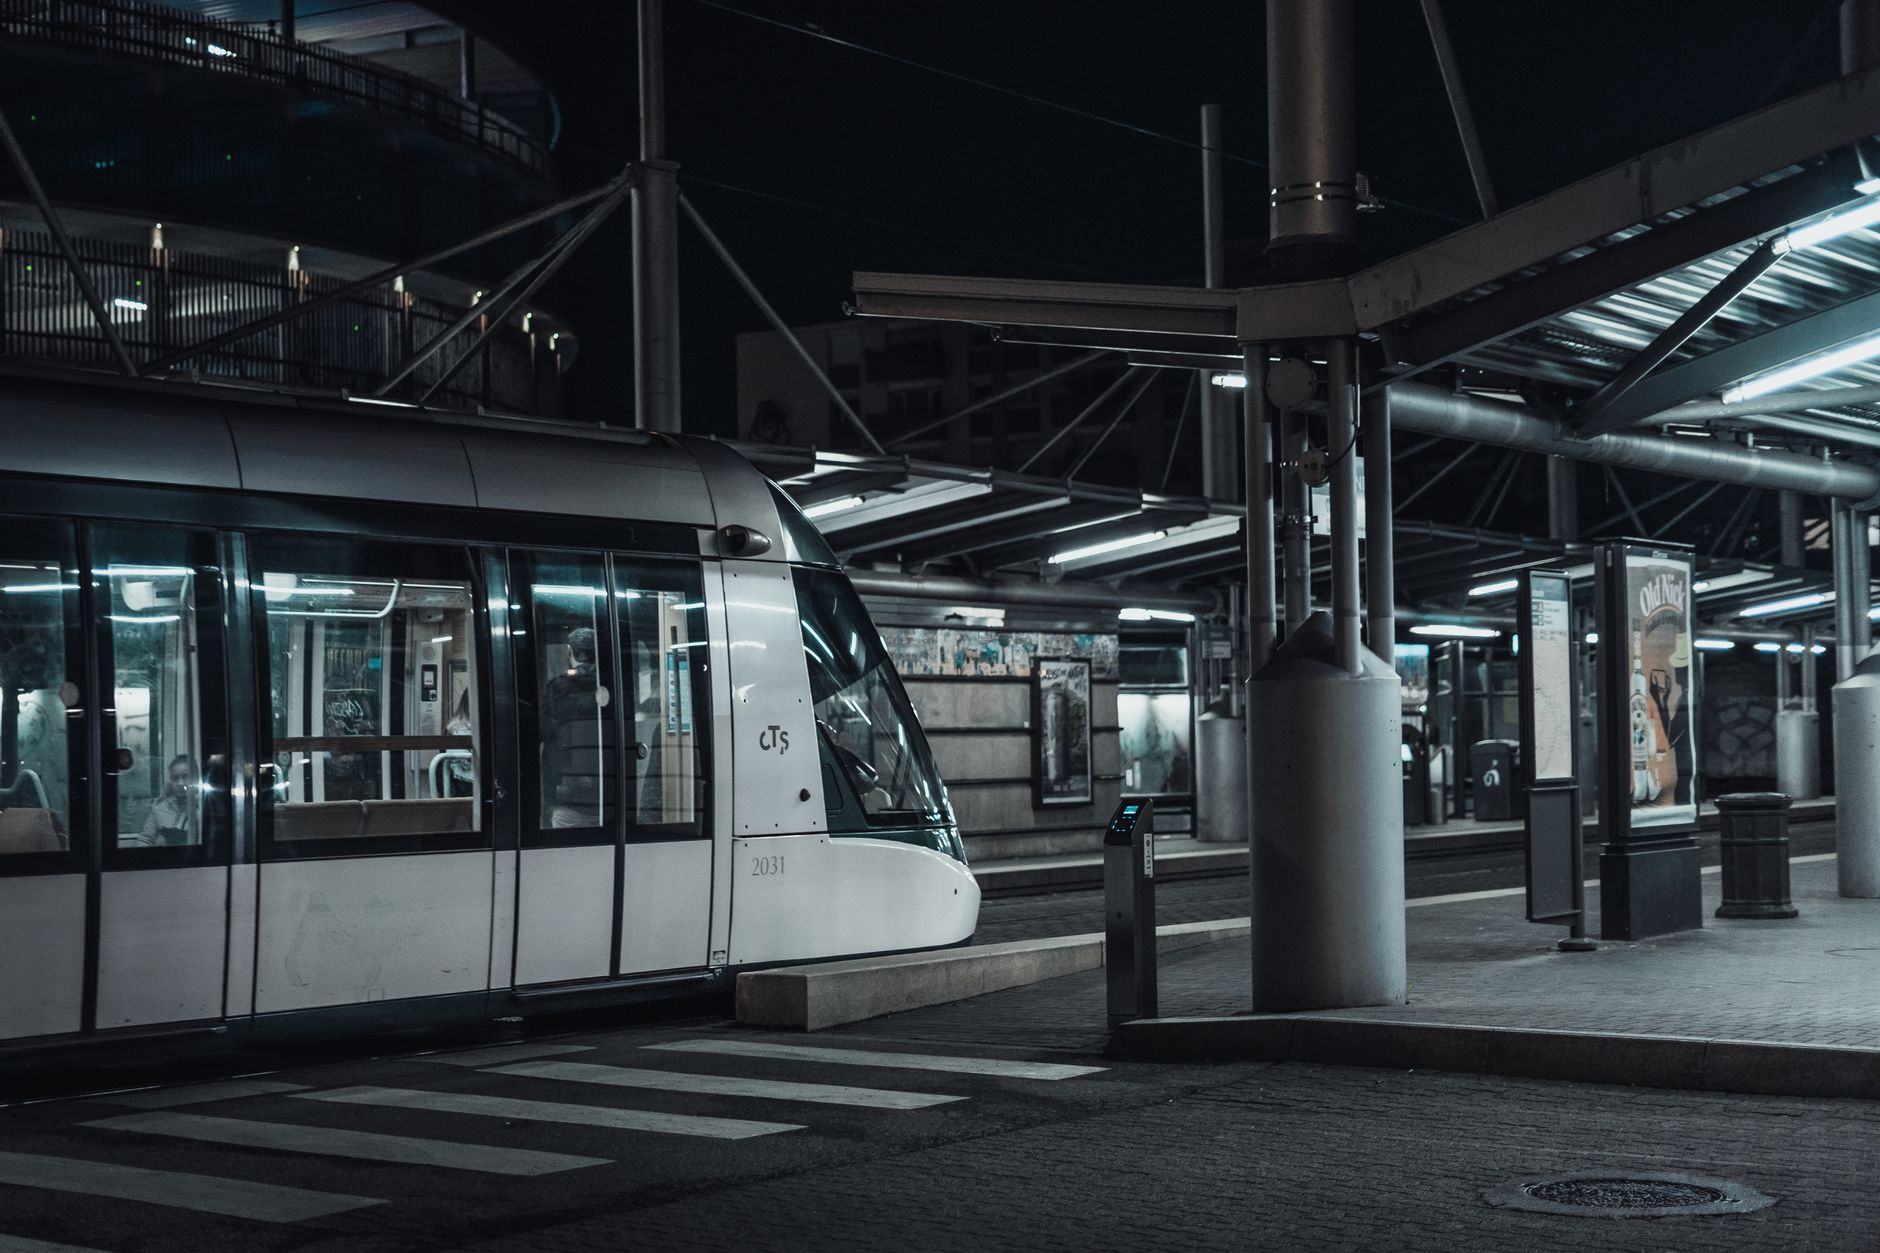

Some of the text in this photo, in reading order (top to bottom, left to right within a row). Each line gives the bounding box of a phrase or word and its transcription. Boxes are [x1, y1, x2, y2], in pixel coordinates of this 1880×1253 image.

[1639, 573, 1686, 617] Old Nick
[759, 725, 790, 755] CTS
[752, 856, 785, 877] 2031
